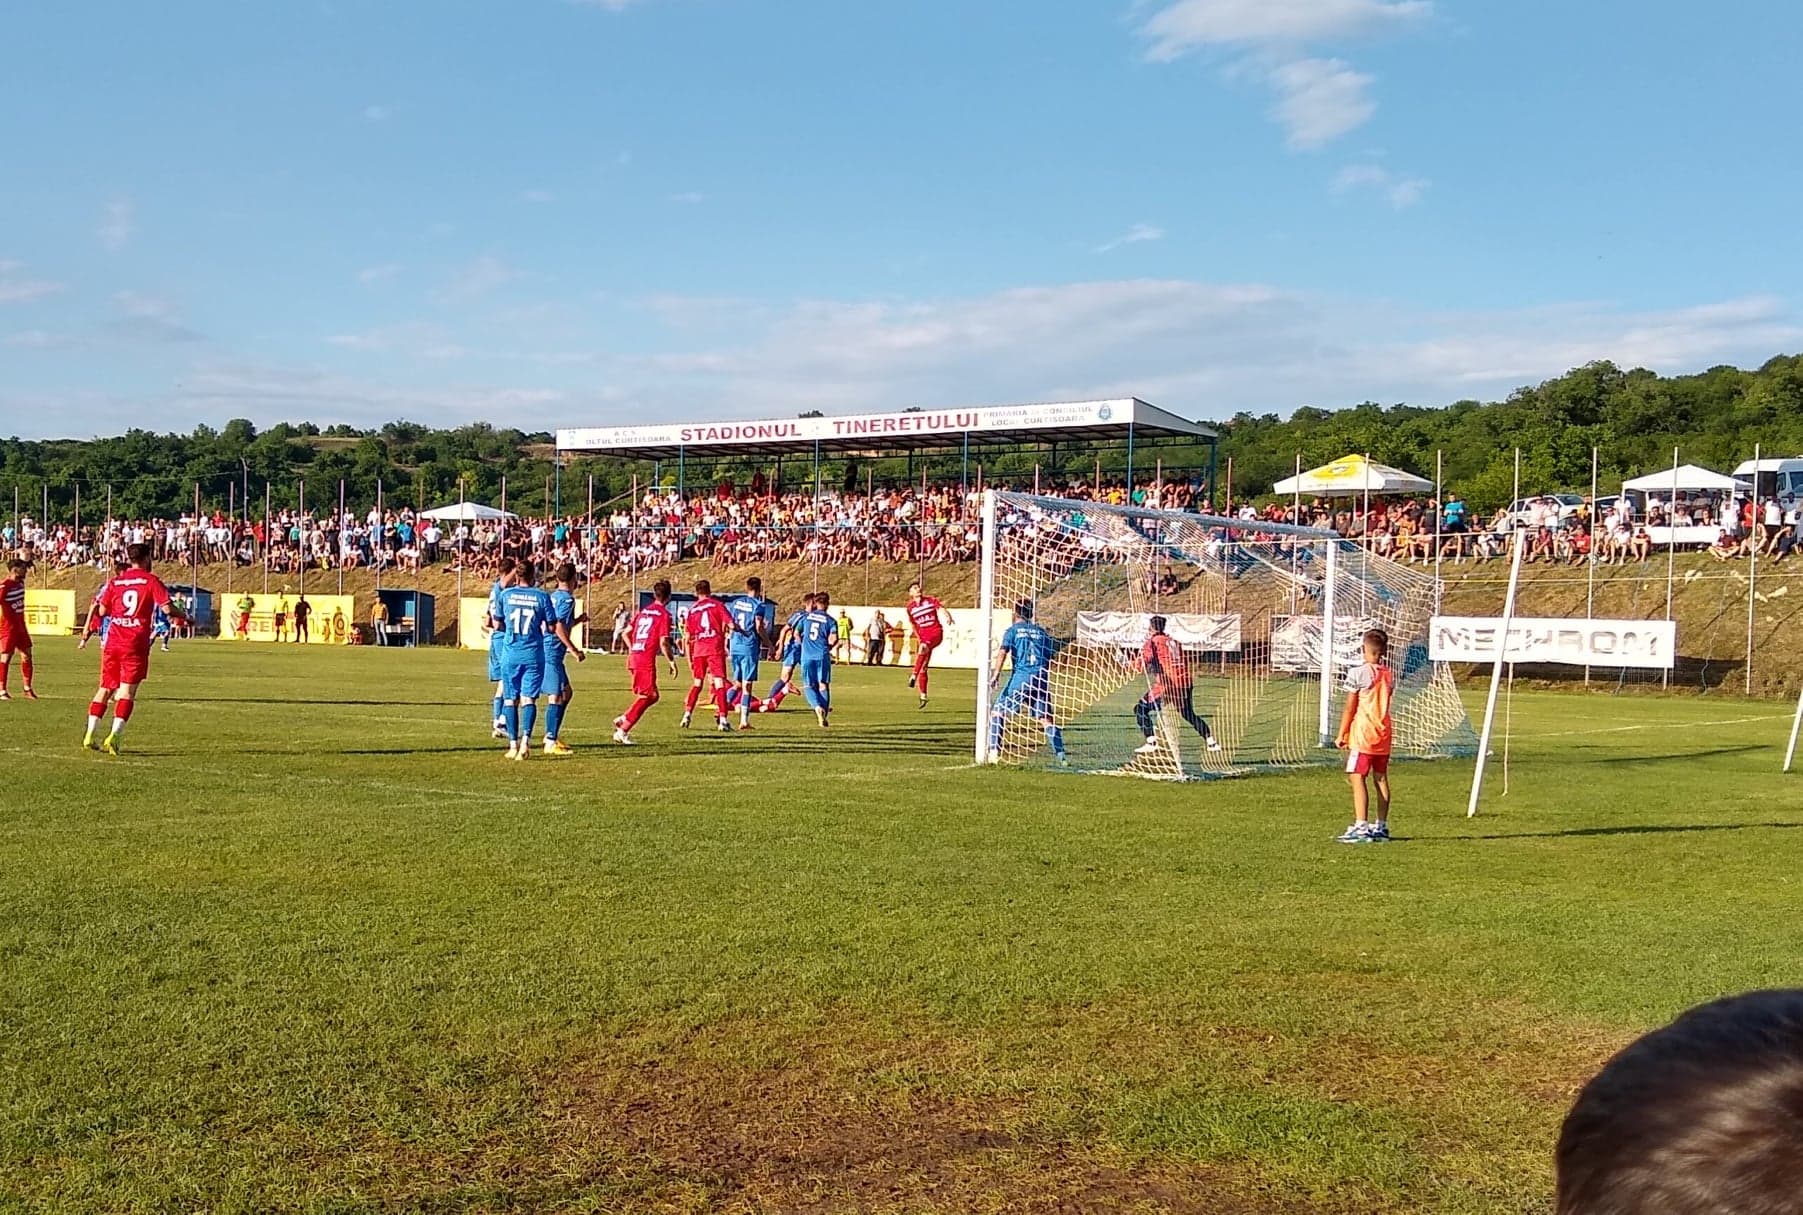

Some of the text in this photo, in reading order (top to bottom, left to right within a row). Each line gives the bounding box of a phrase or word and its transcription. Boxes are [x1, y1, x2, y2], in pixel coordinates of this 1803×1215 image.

[681, 412, 978, 441] STADIONUL TINERETULUI
[122, 589, 138, 617] 9
[509, 608, 536, 635] 17
[700, 611, 710, 633] 4
[809, 622, 820, 641] 5
